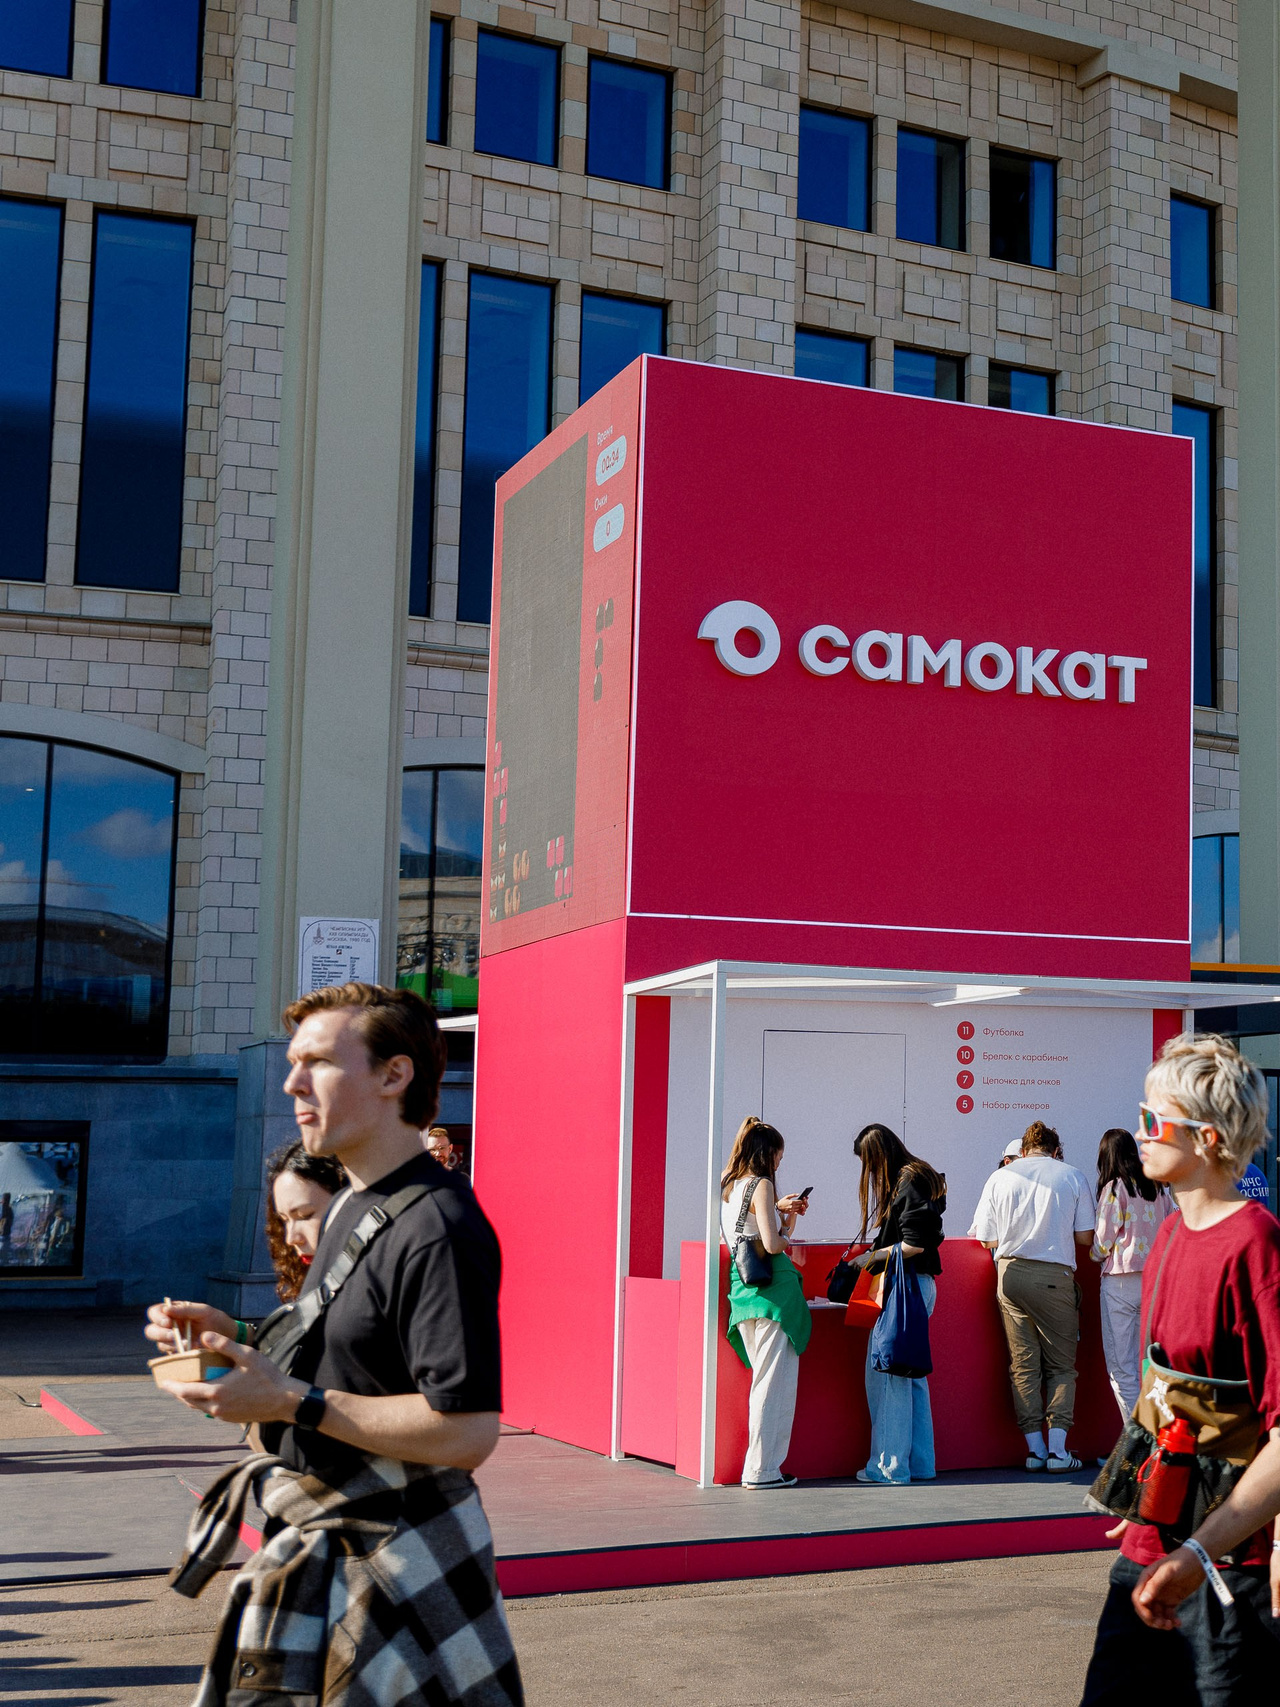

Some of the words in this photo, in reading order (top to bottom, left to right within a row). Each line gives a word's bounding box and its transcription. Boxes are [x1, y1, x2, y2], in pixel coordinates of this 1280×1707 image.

[597, 425, 613, 446] Время
[594, 494, 608, 511] Очки
[605, 520, 611, 537] 0
[962, 1026, 969, 1035] 11
[983, 1028, 1024, 1037] Футболка
[961, 1050, 971, 1060] 10
[982, 1052, 1013, 1061] Брелок
[1022, 1053, 1069, 1063] карабином
[962, 1075, 969, 1084] 7
[982, 1076, 1018, 1085] Цепочка
[1020, 1078, 1035, 1086] для
[961, 1099, 968, 1109] 5
[982, 1101, 1010, 1110] Набор
[1012, 1102, 1050, 1111] стикеров
[1241, 1177, 1261, 1187] МЧС
[1240, 1187, 1269, 1197] ОССИИ
